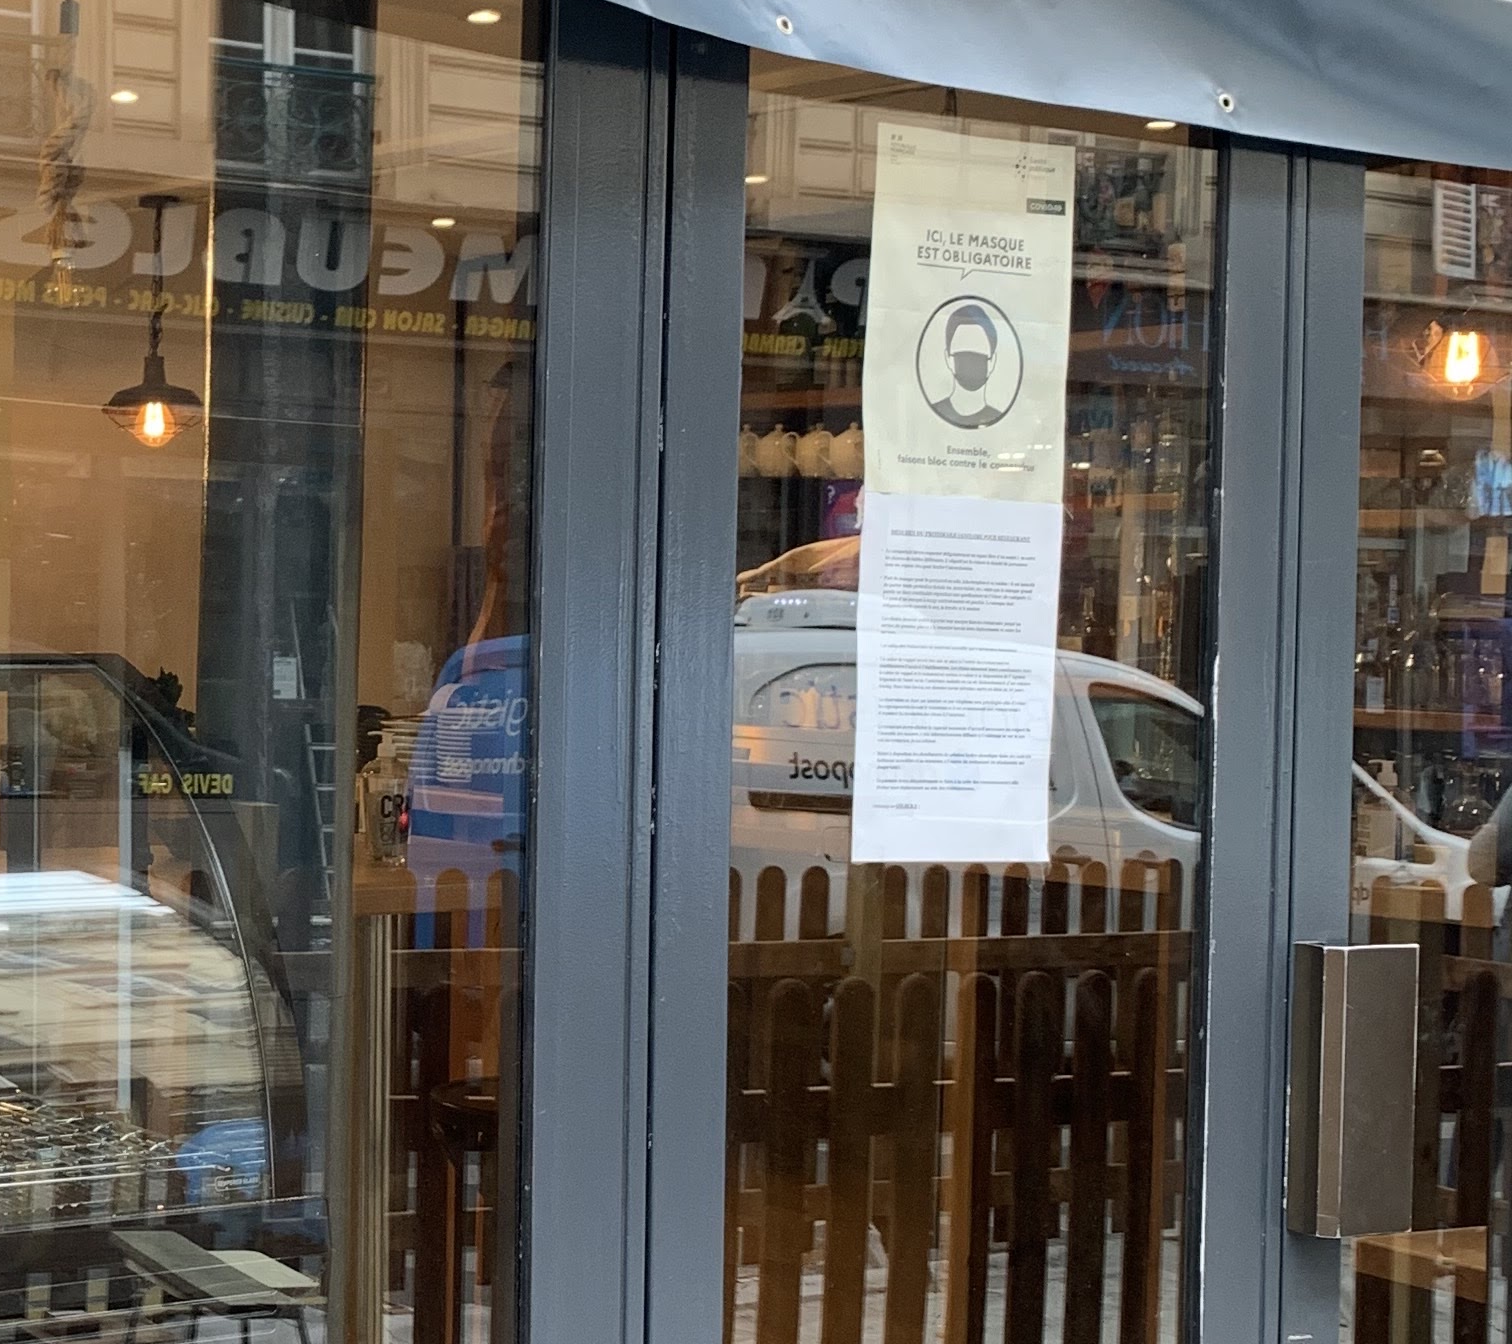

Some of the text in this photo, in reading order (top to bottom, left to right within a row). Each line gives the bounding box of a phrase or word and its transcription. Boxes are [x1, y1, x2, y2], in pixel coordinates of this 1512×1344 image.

[926, 229, 1025, 253] ICI, LE MASQUE
[917, 246, 1032, 270] EST OBLIGATOIRE
[897, 453, 988, 470] faisons bloc contre le
